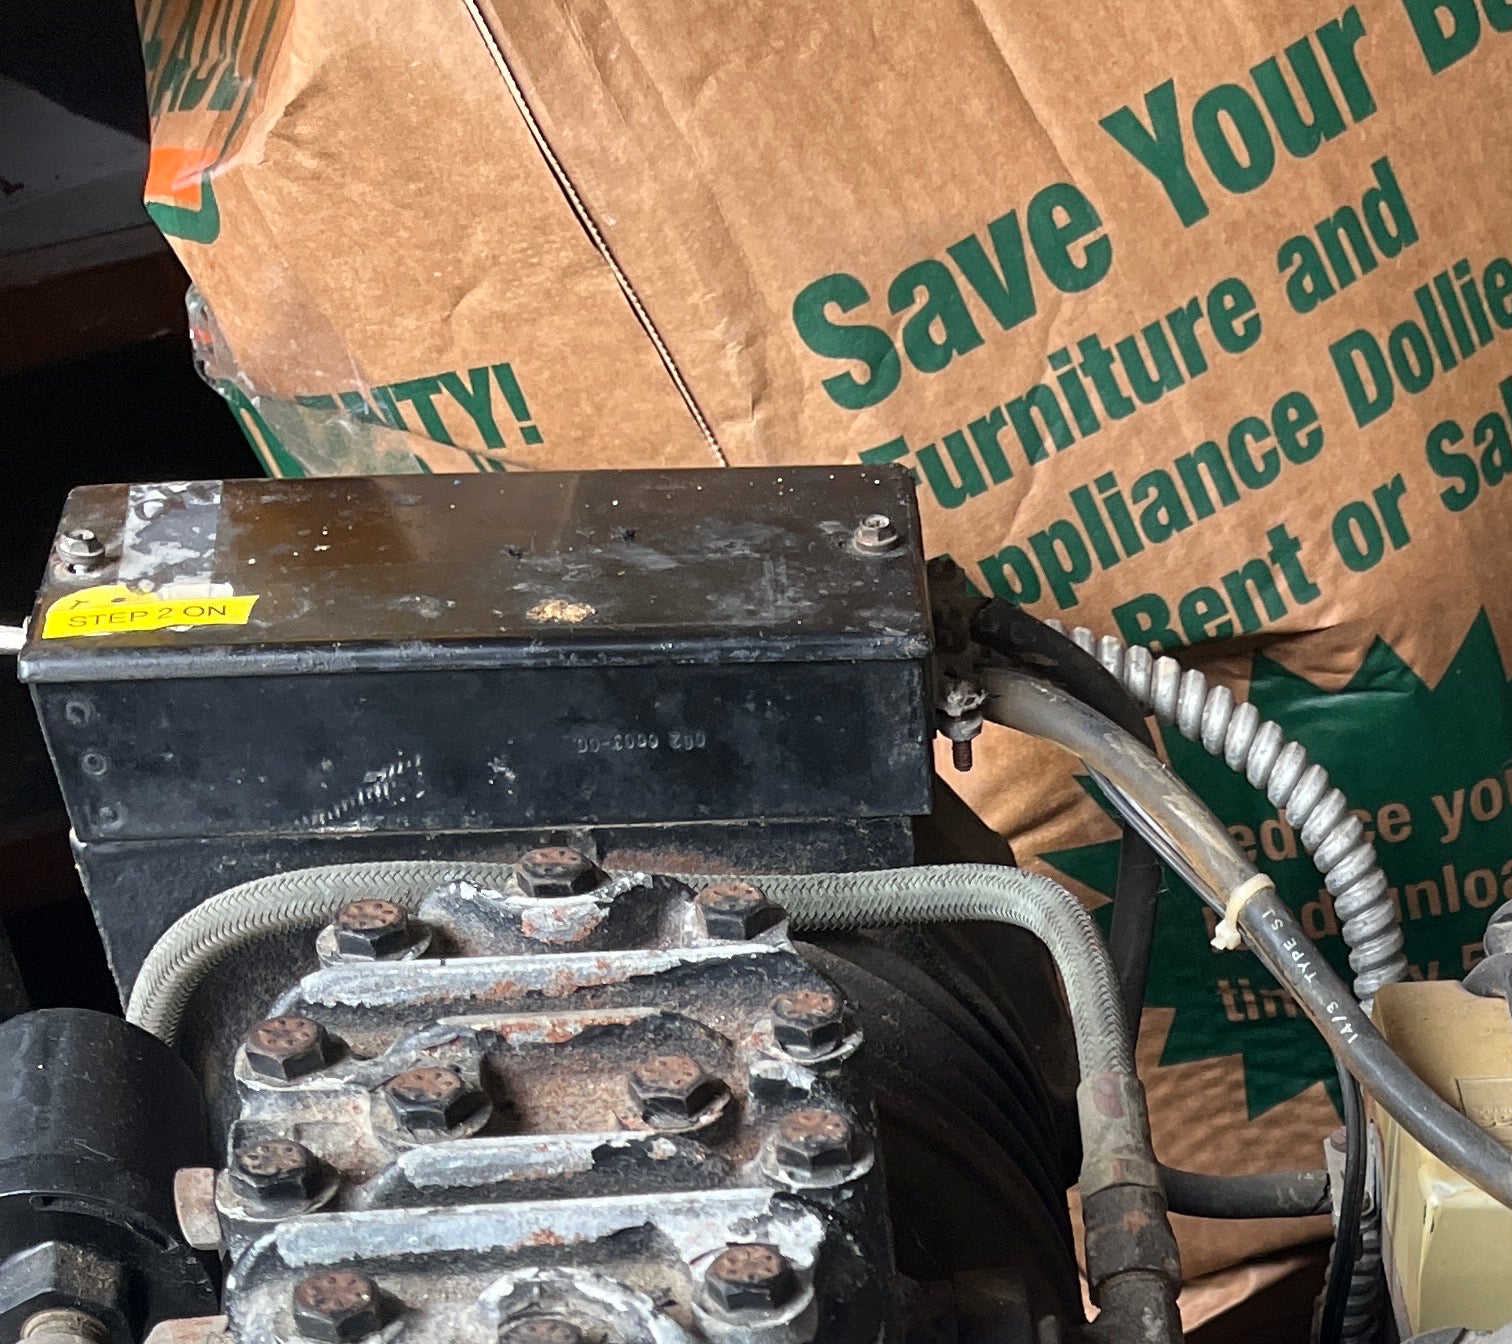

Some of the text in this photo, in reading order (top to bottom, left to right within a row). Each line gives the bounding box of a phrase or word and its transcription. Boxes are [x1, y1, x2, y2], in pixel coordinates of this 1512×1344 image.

[792, 182, 1113, 410] Save
[1098, 5, 1377, 228] Your
[1277, 156, 1419, 314] and
[966, 391, 1325, 610] ppliance
[69, 605, 227, 628] STEP 2 ON
[1111, 523, 1321, 655] Rent
[1332, 471, 1410, 573] or
[1227, 802, 1413, 863] edce
[1283, 937, 1317, 983] TYPE
[1326, 1001, 1358, 1044] 14/3
